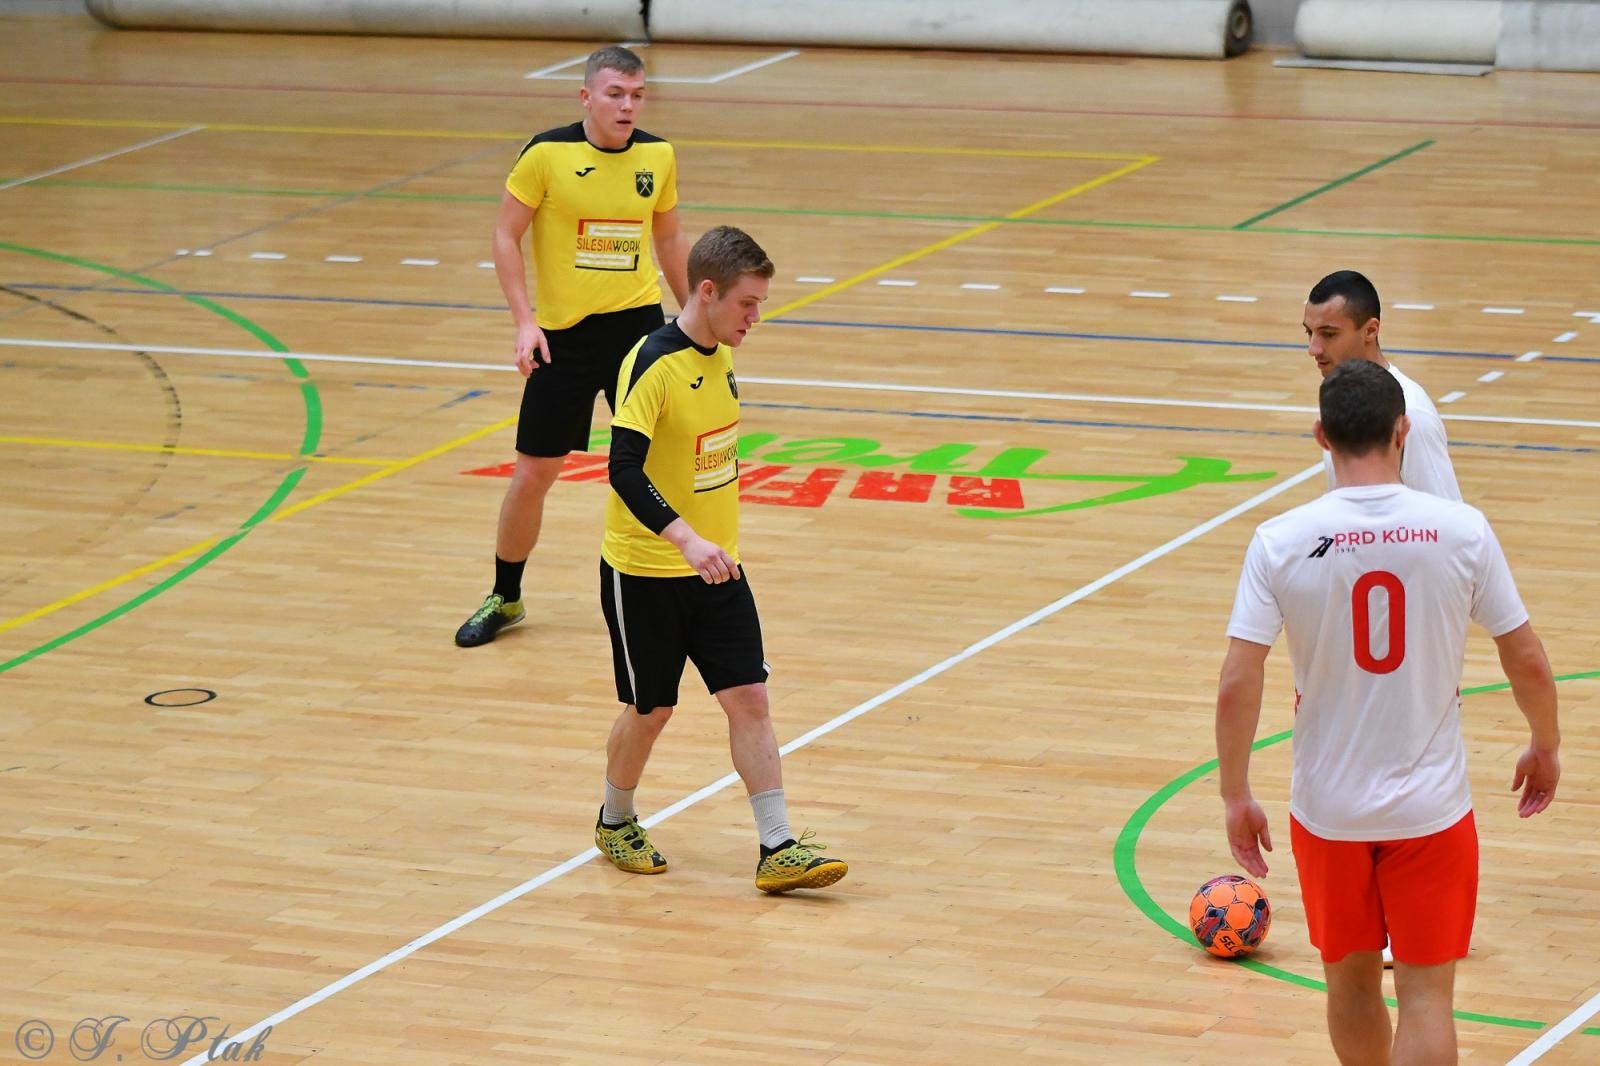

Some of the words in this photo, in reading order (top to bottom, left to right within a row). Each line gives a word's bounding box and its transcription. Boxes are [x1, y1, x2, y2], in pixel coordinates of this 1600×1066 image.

[576, 237, 641, 253] SILESIAWORK
[1334, 530, 1376, 547] PRD
[1382, 526, 1438, 544] KÜHN
[1351, 570, 1406, 675] 0
